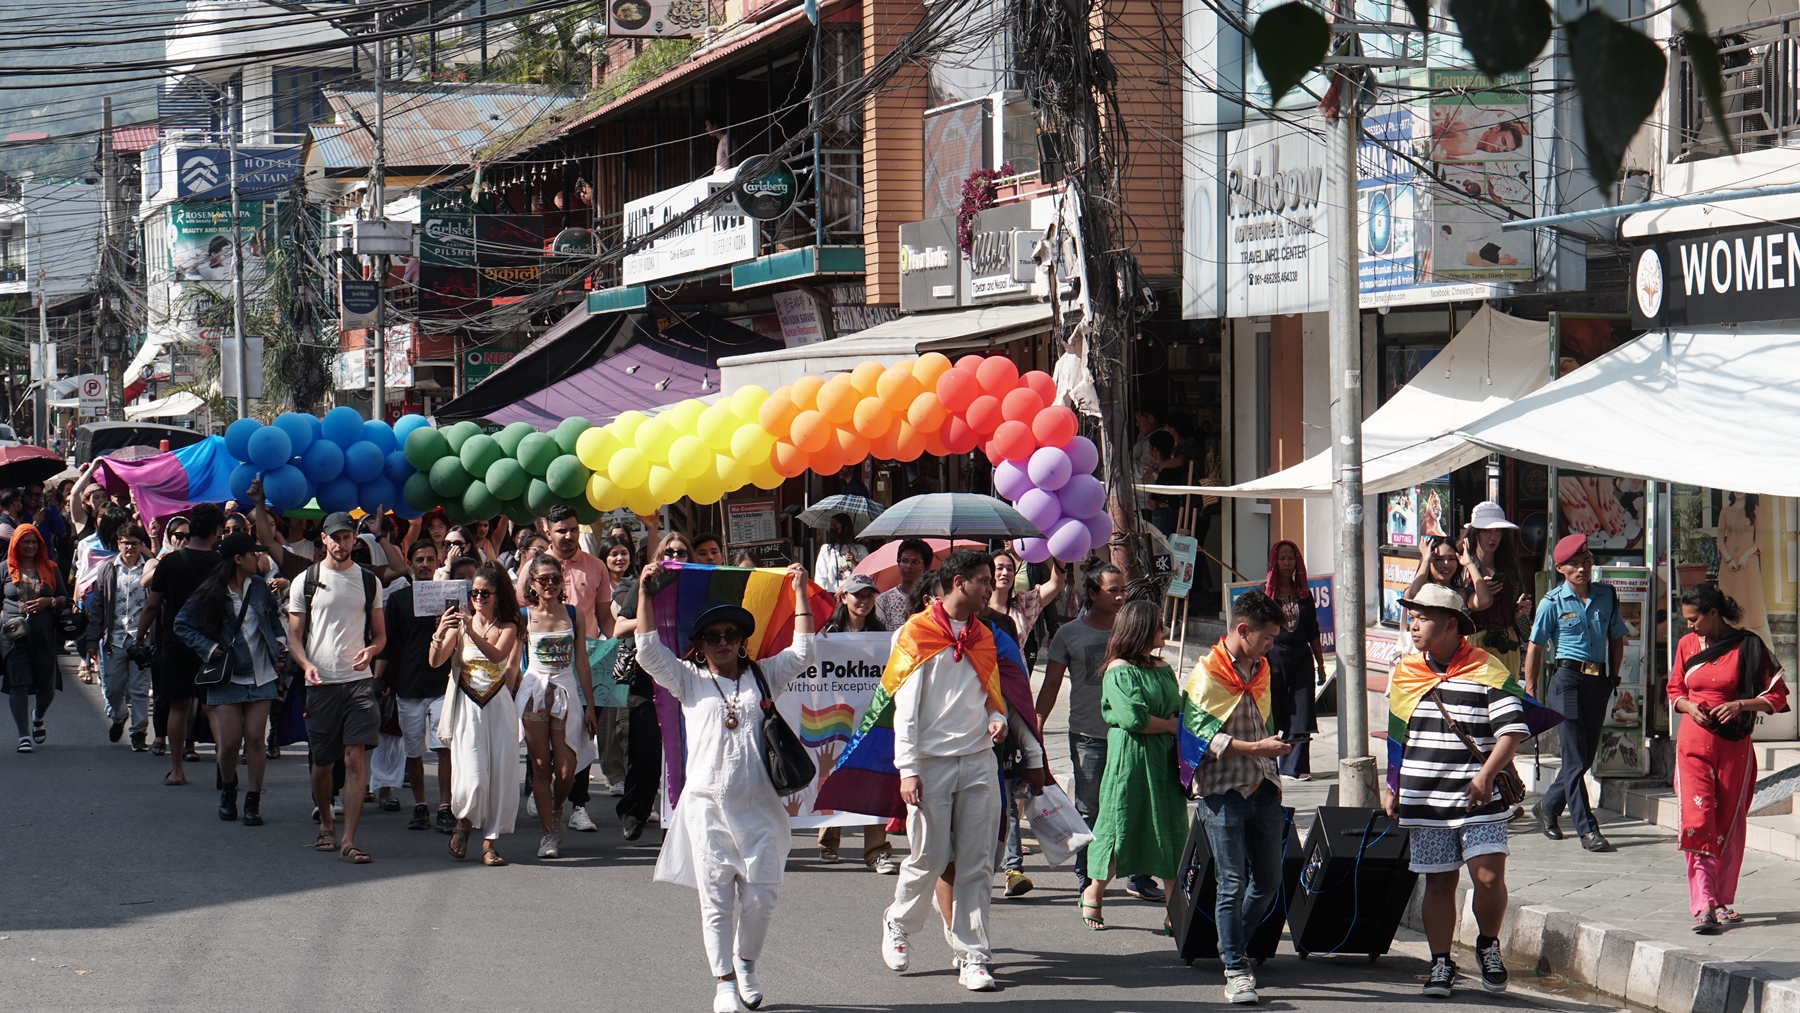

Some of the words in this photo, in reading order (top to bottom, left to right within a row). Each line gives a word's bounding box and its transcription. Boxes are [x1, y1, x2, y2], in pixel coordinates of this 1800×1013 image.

[1433, 72, 1497, 91] Pampering
[1500, 73, 1523, 91] Day
[244, 158, 297, 169] HOTEL
[743, 181, 788, 198] Carlsberg
[1227, 142, 1322, 220] Rainbow
[425, 218, 474, 239] Carlsbe
[1234, 221, 1276, 244] ADVENTURE
[1241, 249, 1263, 265] TRAVEL
[1265, 248, 1278, 262] INFO
[1281, 244, 1307, 260] CENTER
[832, 285, 867, 304] HIMALAYA
[1395, 565, 1417, 583] Mountai
[1309, 585, 1330, 609] US
[785, 682, 828, 692] Without
[831, 681, 881, 694] Exceptio
